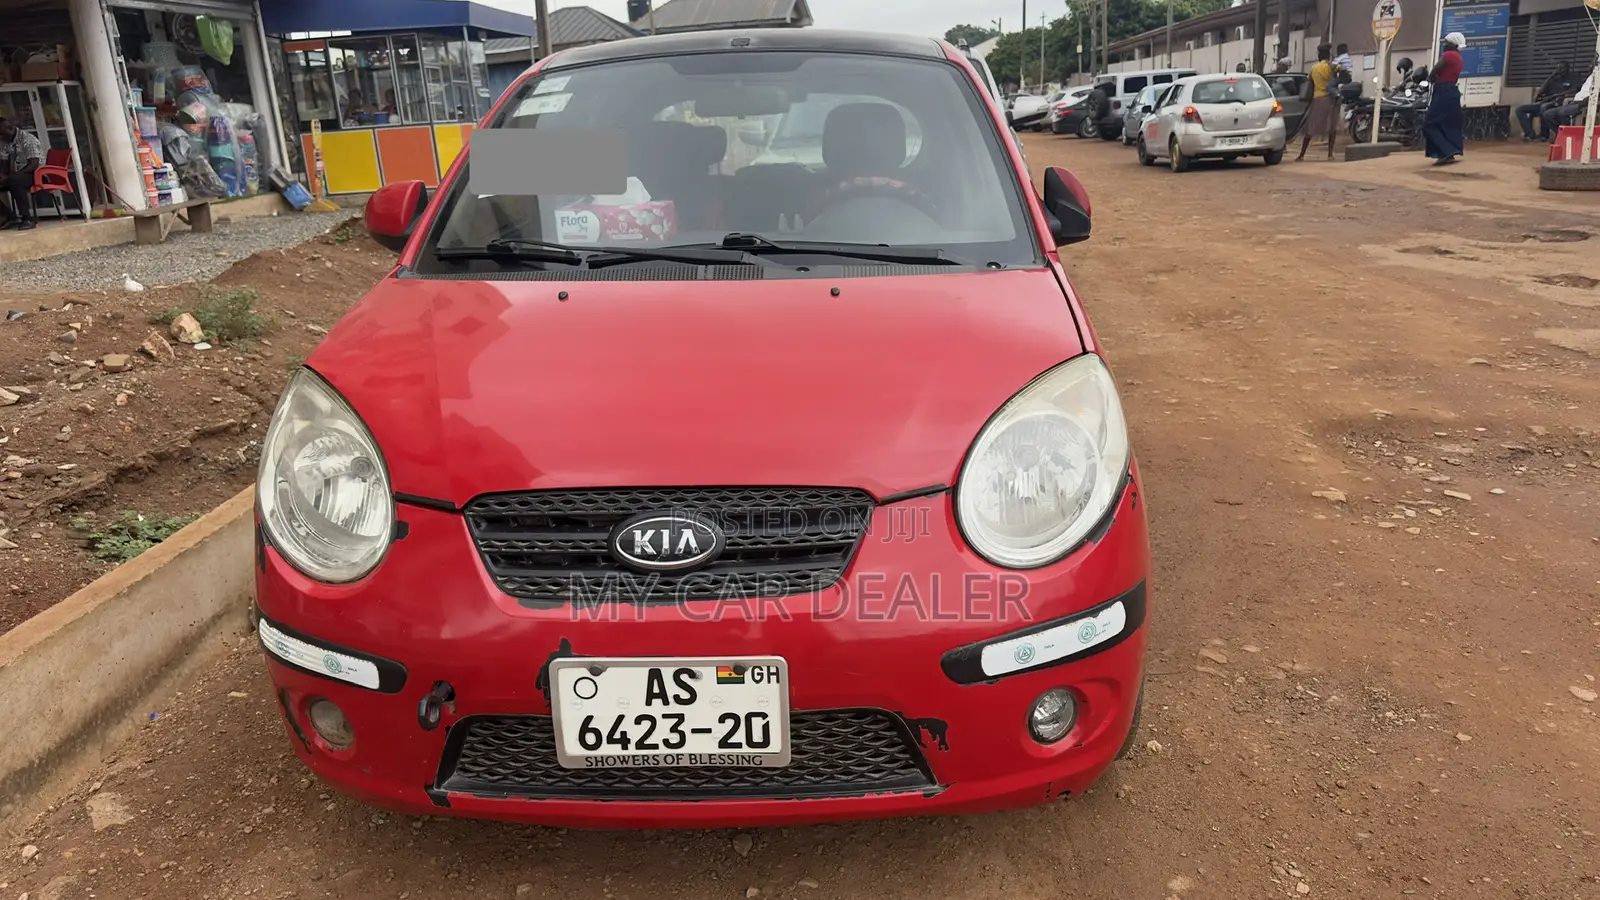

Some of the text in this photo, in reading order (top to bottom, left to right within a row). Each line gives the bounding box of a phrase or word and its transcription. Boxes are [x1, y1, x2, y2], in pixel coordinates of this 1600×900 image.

[560, 215, 588, 228] Flora
[632, 528, 701, 555] KIA
[644, 666, 780, 707] AS GH
[578, 712, 771, 751] 6423-20
[585, 752, 763, 767] SHOWERS OF BLESSING
